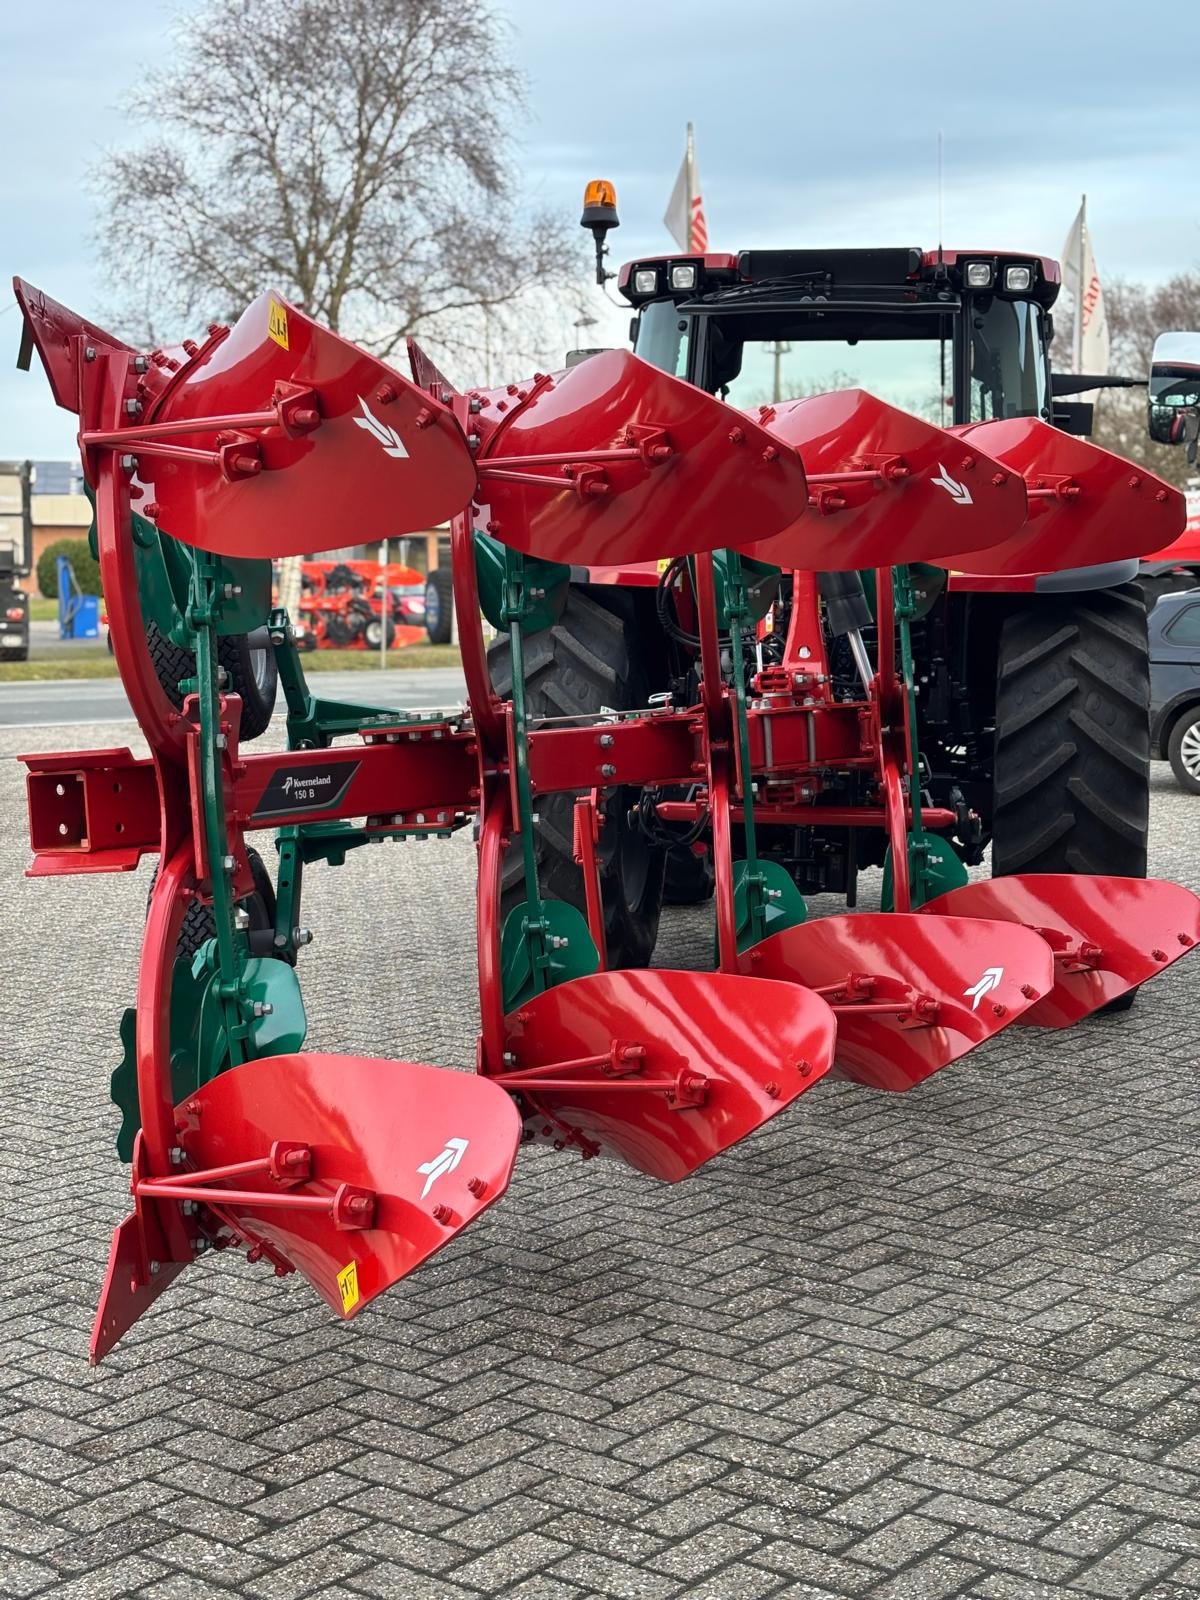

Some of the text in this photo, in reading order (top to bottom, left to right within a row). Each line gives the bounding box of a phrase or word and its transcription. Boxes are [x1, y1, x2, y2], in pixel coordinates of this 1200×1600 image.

[293, 775, 331, 788] Kverneland
[294, 789, 315, 799] 150 B
